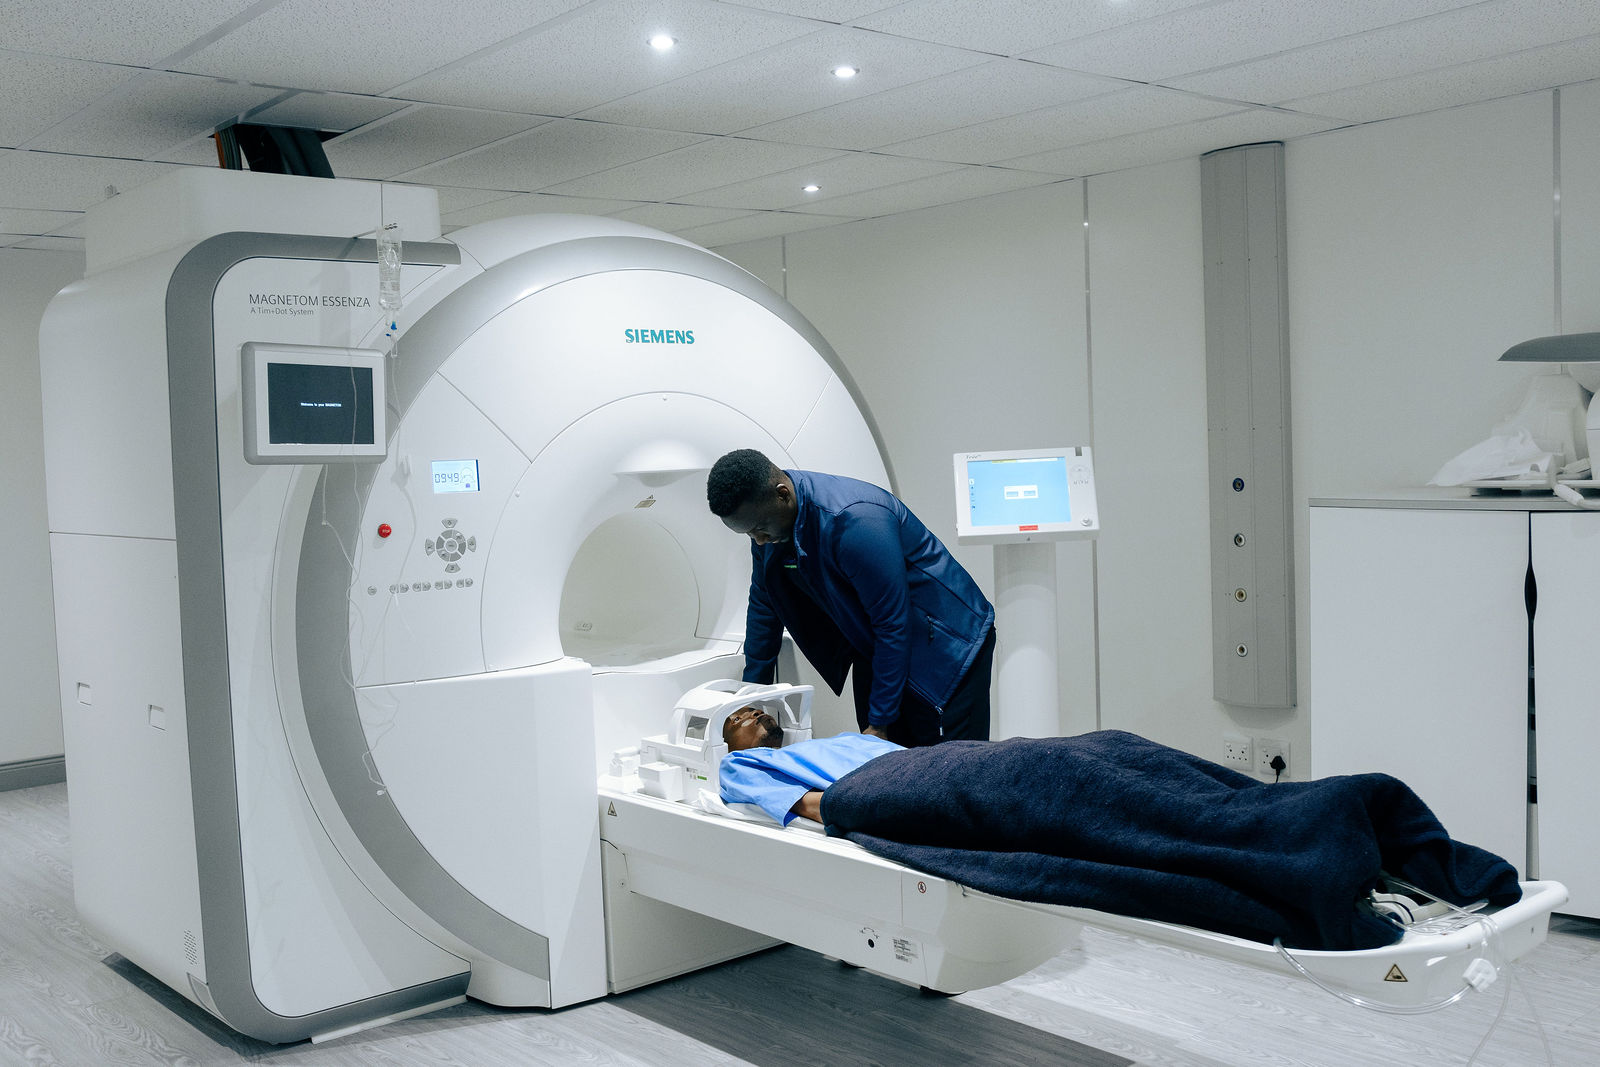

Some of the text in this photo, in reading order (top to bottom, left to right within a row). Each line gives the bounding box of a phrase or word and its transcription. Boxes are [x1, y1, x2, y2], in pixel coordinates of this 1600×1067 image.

[249, 294, 371, 308] MAGNETOM ESSENZA
[289, 308, 314, 317] System
[624, 328, 695, 345] SIEMENS
